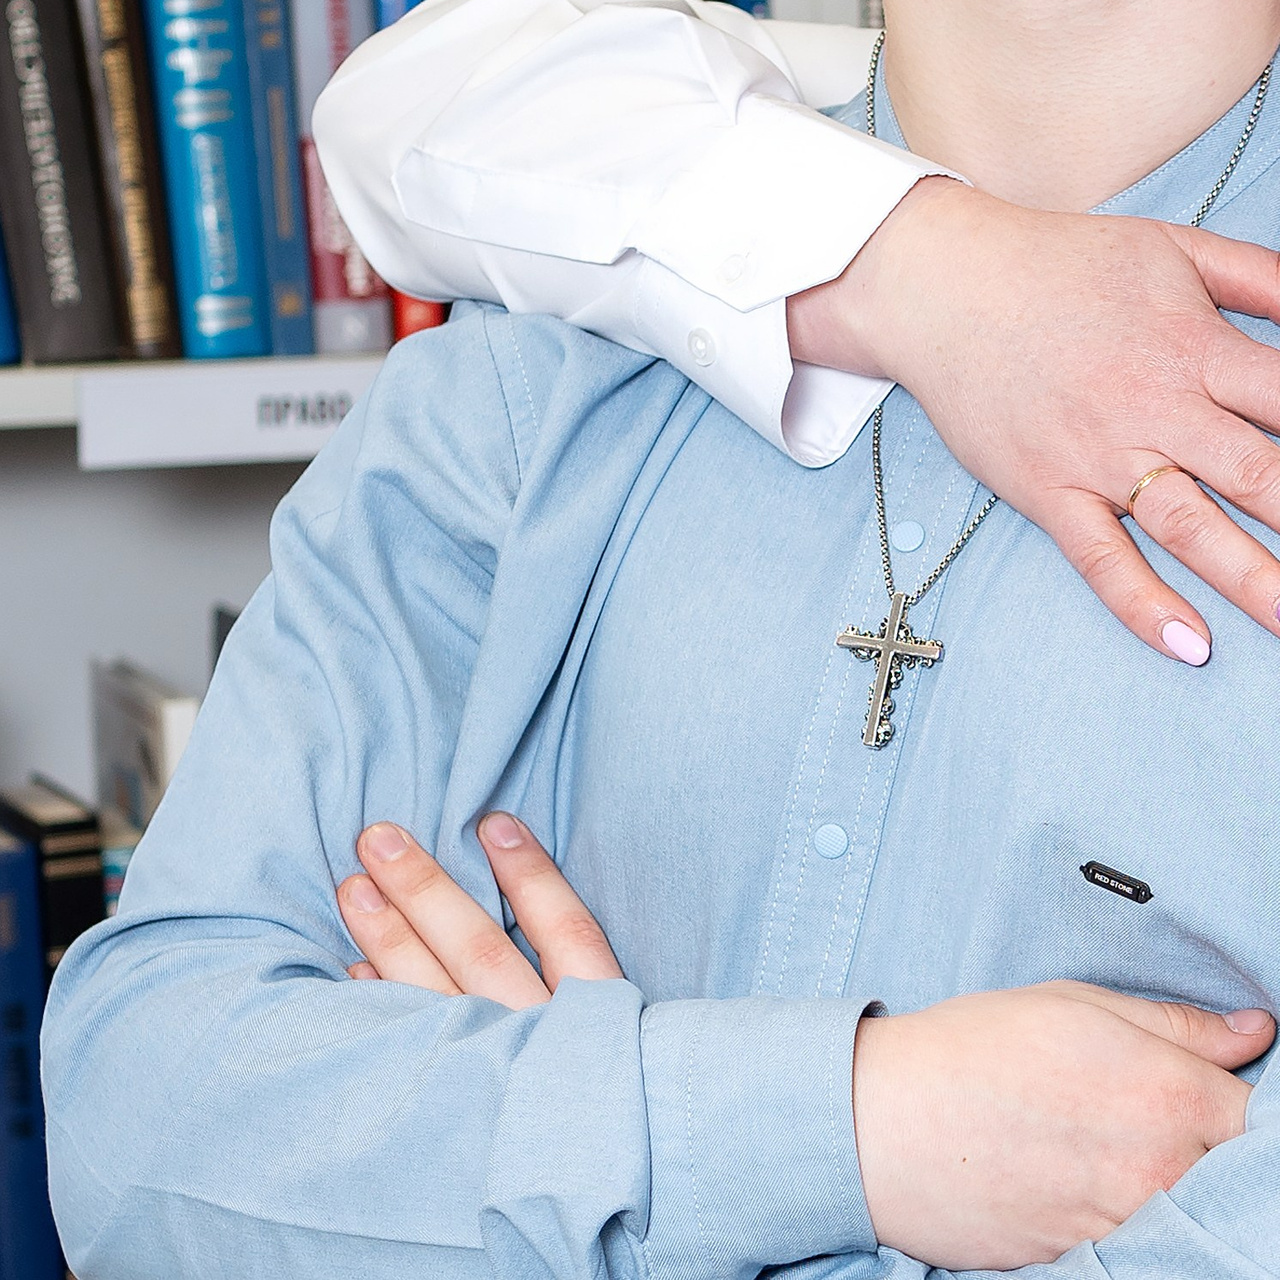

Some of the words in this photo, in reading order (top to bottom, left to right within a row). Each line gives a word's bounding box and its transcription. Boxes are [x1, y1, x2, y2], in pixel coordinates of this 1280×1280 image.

[257, 392, 353, 429] ПРАВО
[1095, 873, 1109, 884] RED
[1110, 879, 1133, 894] STONE
